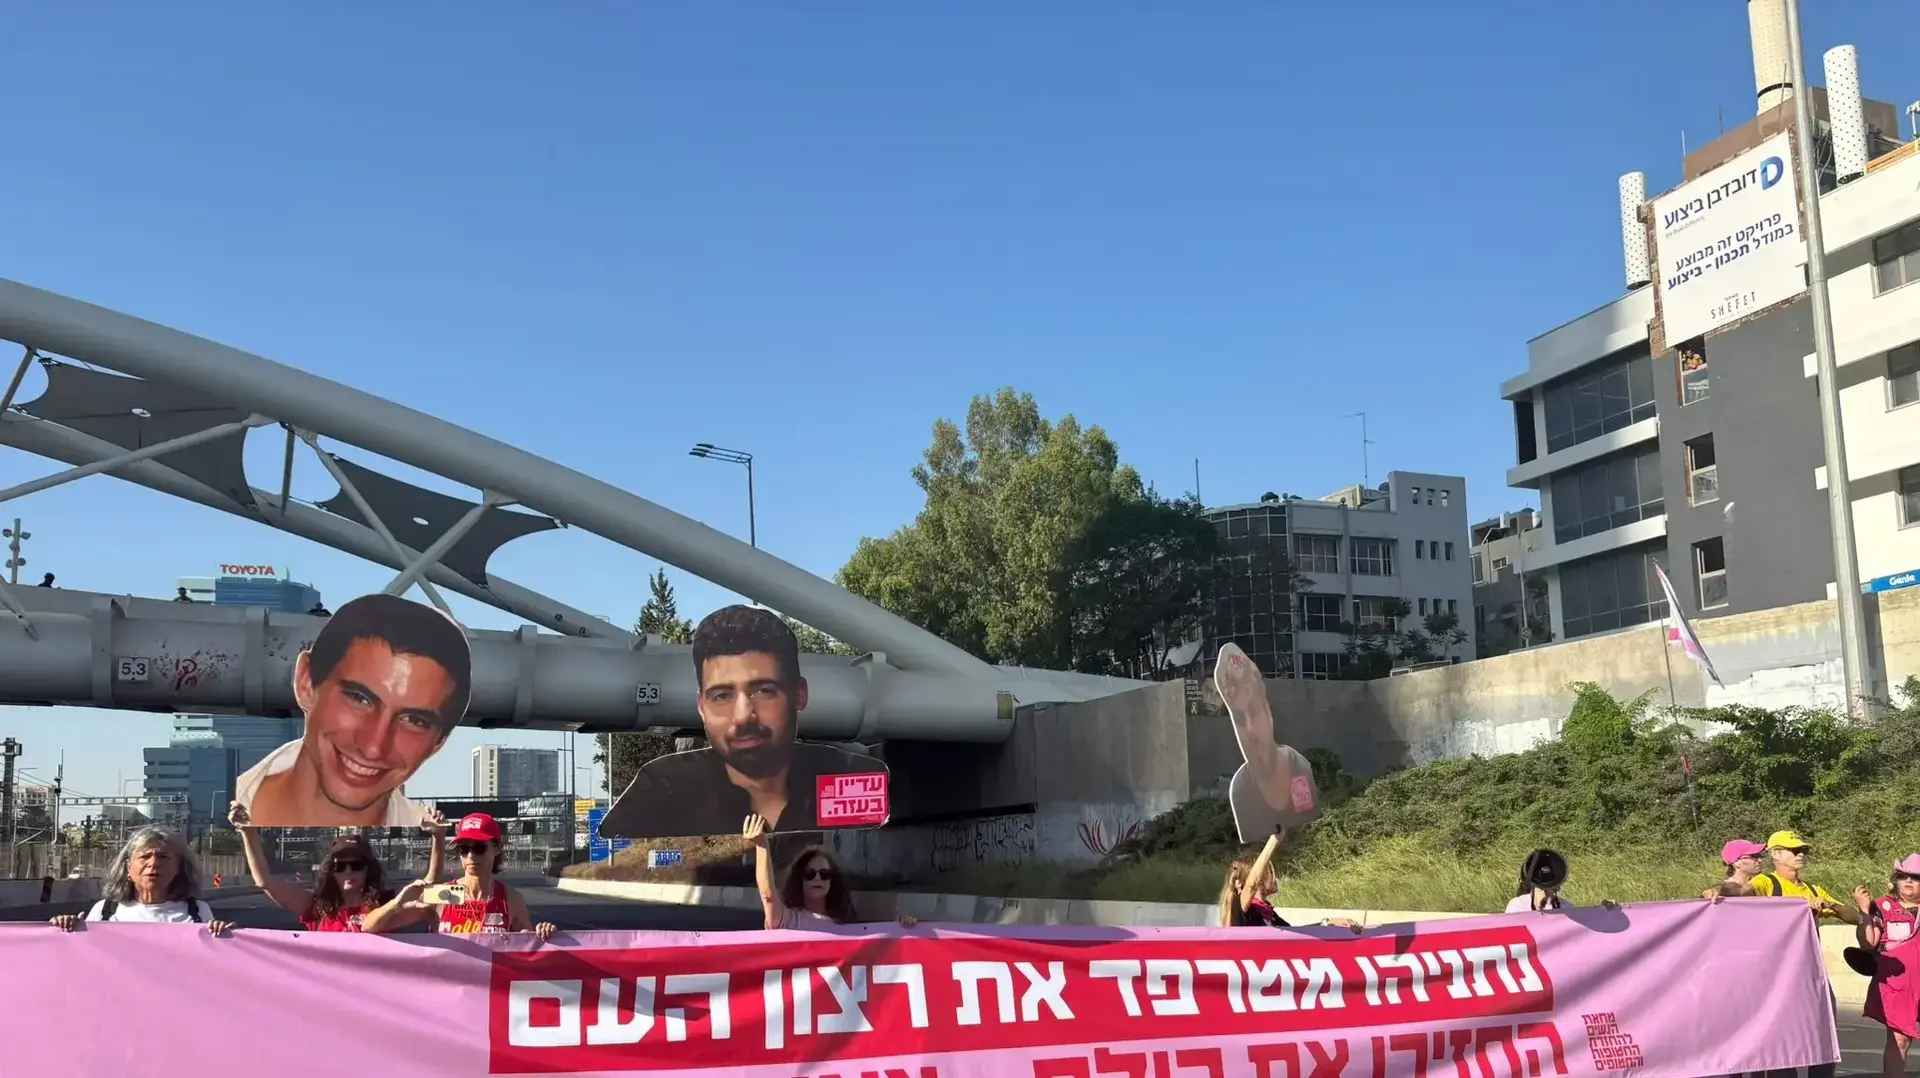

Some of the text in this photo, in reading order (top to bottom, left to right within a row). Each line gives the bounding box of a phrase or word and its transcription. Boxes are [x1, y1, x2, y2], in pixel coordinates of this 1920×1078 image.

[1706, 168, 1757, 209] דובדבן
[1664, 198, 1704, 230] ביצוע
[1736, 213, 1781, 243] פרויקט
[1753, 223, 1794, 250] במודל
[1718, 235, 1732, 252] זה
[1675, 245, 1714, 272] מבוצע
[1715, 244, 1750, 269] תכנון
[1668, 266, 1703, 290] ביצוע
[1711, 291, 1755, 319] SHEFET
[220, 564, 275, 576] TOYOTA
[121, 662, 146, 676] 5.3
[638, 687, 658, 699] 5.3
[839, 777, 882, 796] עדיין
[828, 798, 883, 815] בעזה.
[508, 942, 1545, 1050] נתניהו מטרפד את רצון העם
[1581, 1012, 1616, 1025] מחאת
[1586, 1023, 1619, 1037] הנשים
[1371, 1021, 1568, 1078] החזירו
[1591, 1044, 1641, 1060] החטופות
[1594, 1056, 1644, 1071] והחטופים
